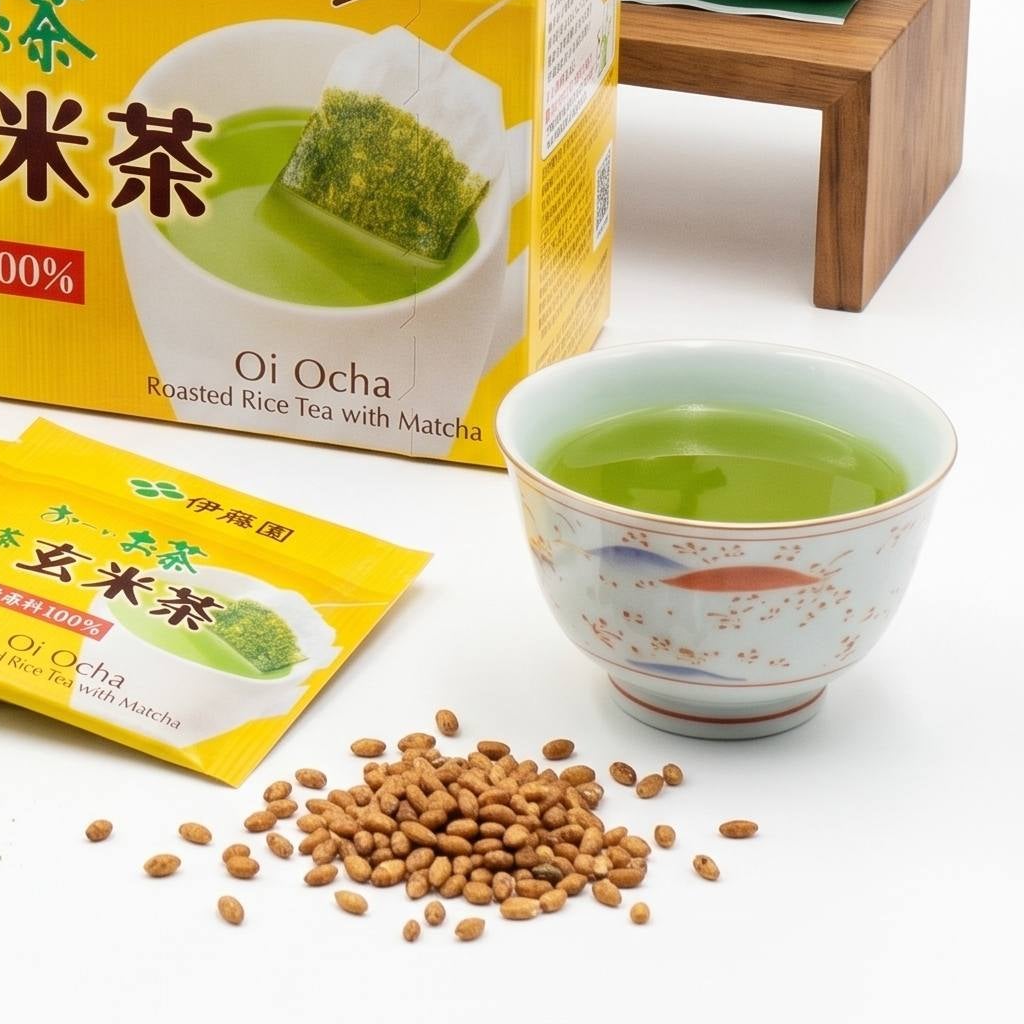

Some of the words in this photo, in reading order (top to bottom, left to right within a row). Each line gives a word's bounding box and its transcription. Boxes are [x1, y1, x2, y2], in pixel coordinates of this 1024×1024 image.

[235, 350, 277, 384] Oi
[294, 358, 391, 399] Ocha
[147, 376, 233, 407] Roasted
[242, 389, 289, 414] Rice
[295, 396, 333, 421] Tea
[341, 405, 389, 429] with
[399, 410, 483, 442] Matcha
[185, 496, 296, 544] 伊藤園
[16, 539, 225, 631] 玄米茶
[7, 634, 46, 658] Oi
[51, 649, 126, 689] Ocha
[8, 656, 43, 677] Rice
[48, 670, 73, 689] Tea
[78, 683, 115, 705] with
[118, 696, 184, 730] Matcha
